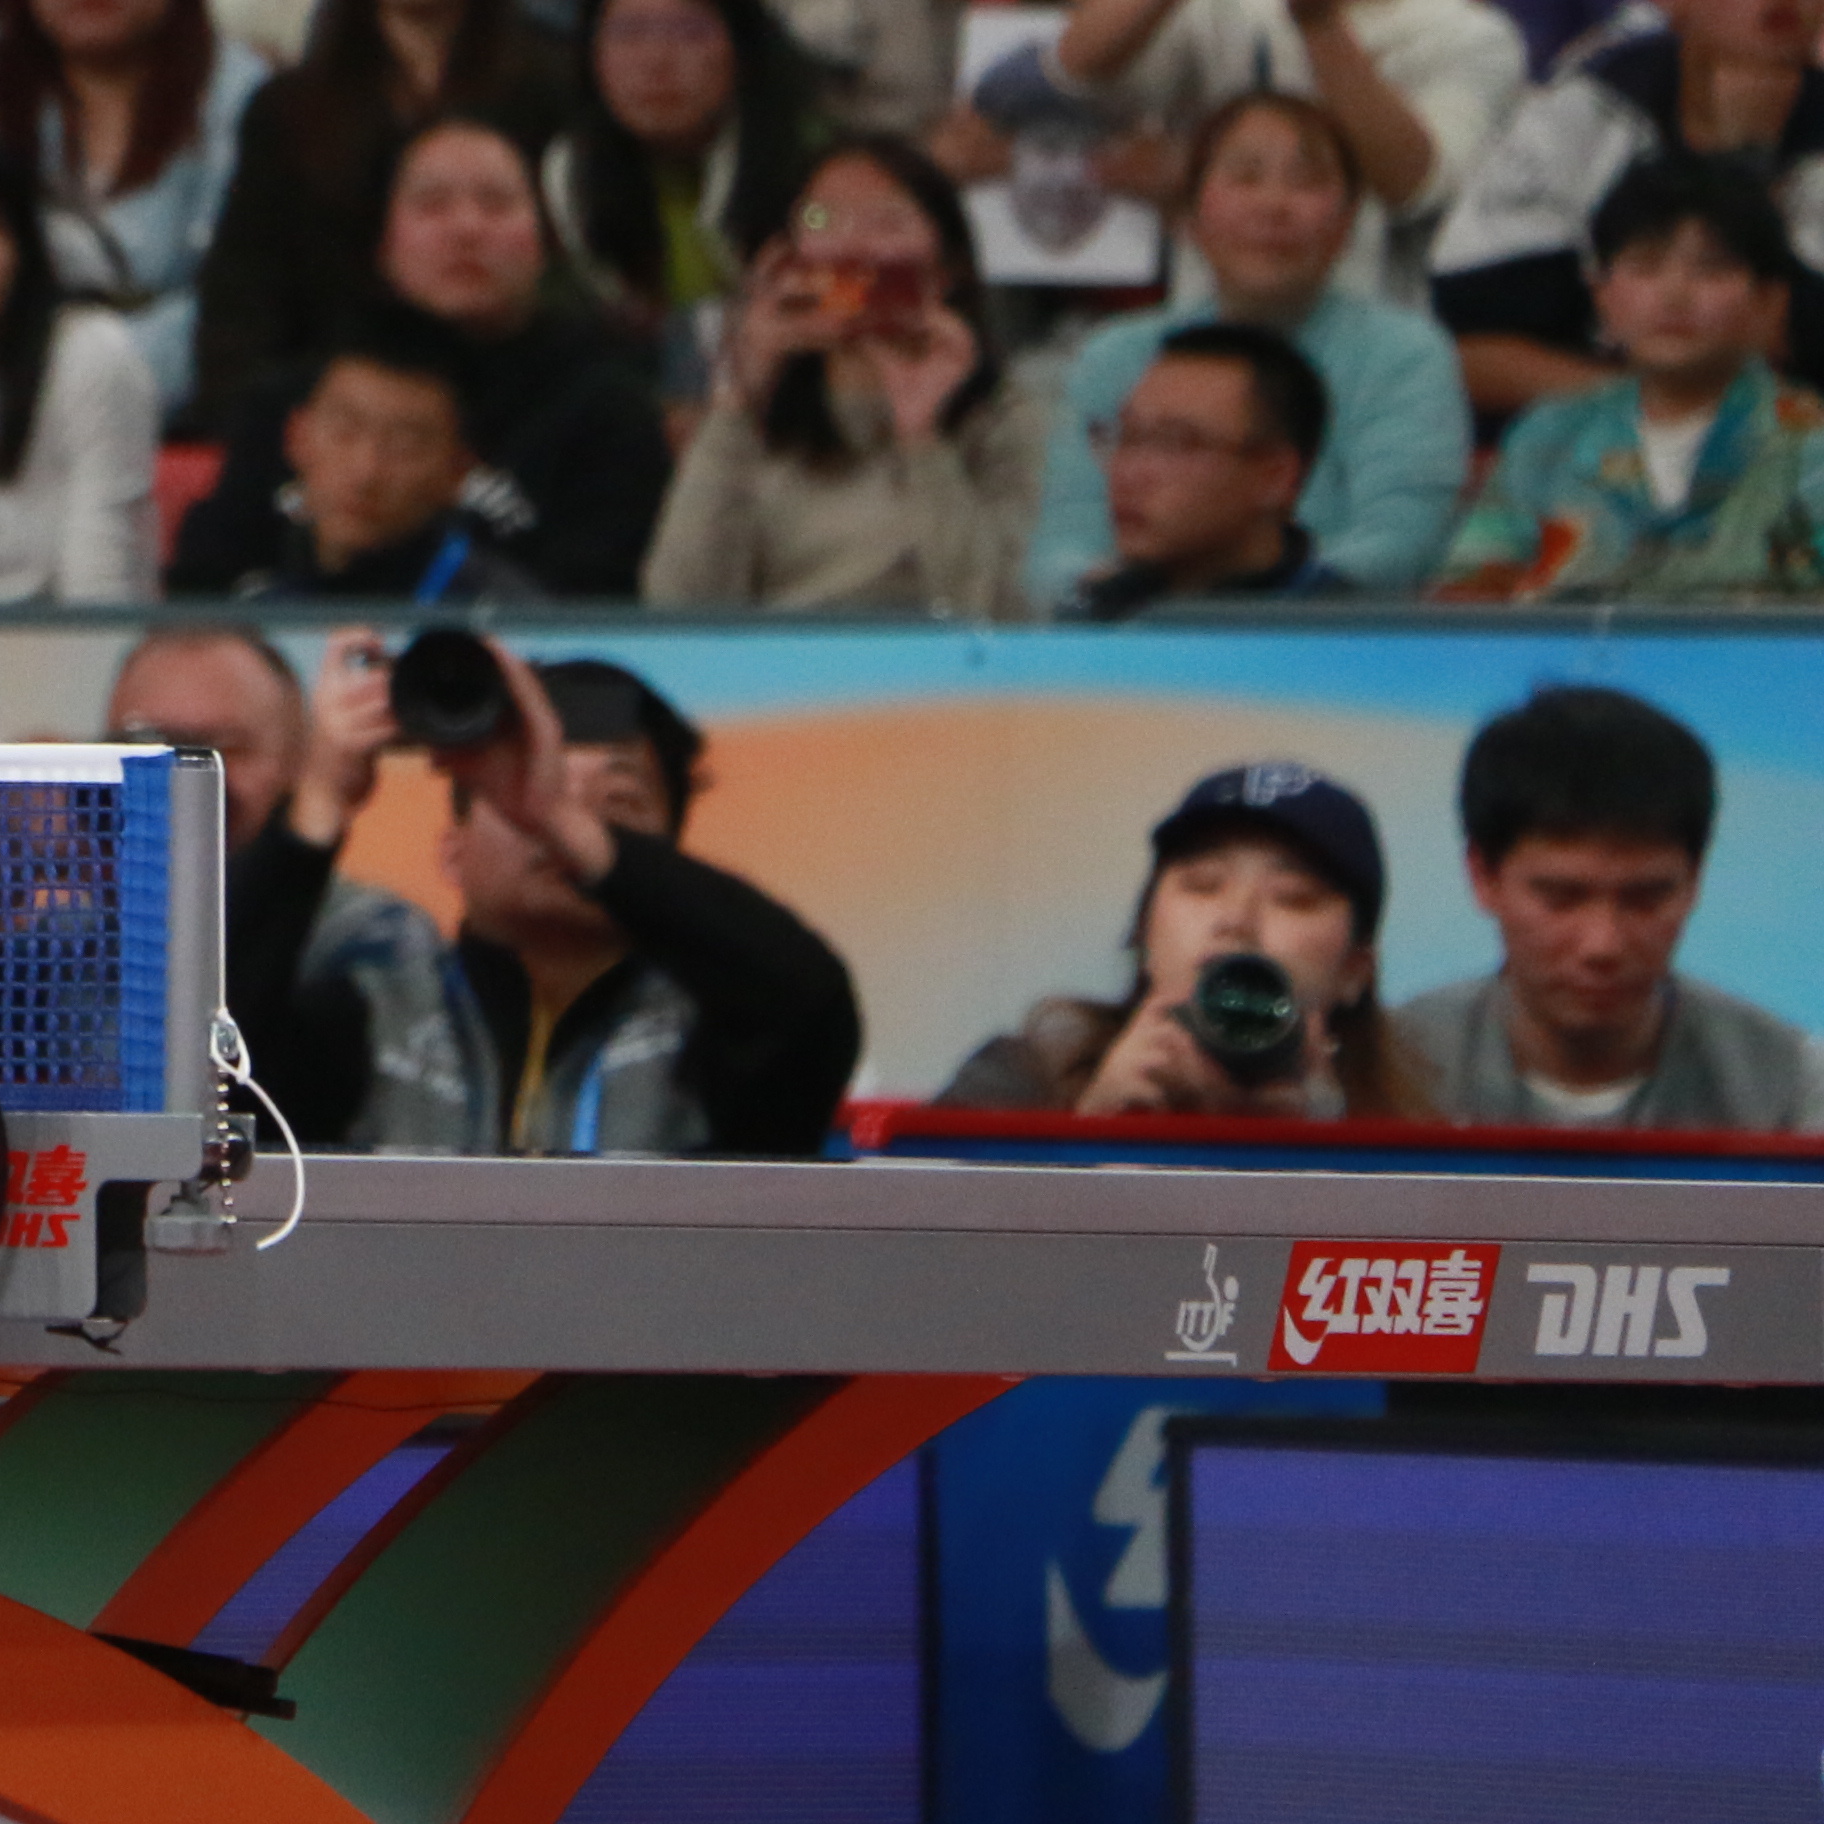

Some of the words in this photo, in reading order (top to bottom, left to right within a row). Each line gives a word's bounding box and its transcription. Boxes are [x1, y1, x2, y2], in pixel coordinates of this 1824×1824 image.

[1296, 1249, 1485, 1337] 红双喜
[1526, 1263, 1732, 1358] DHS
